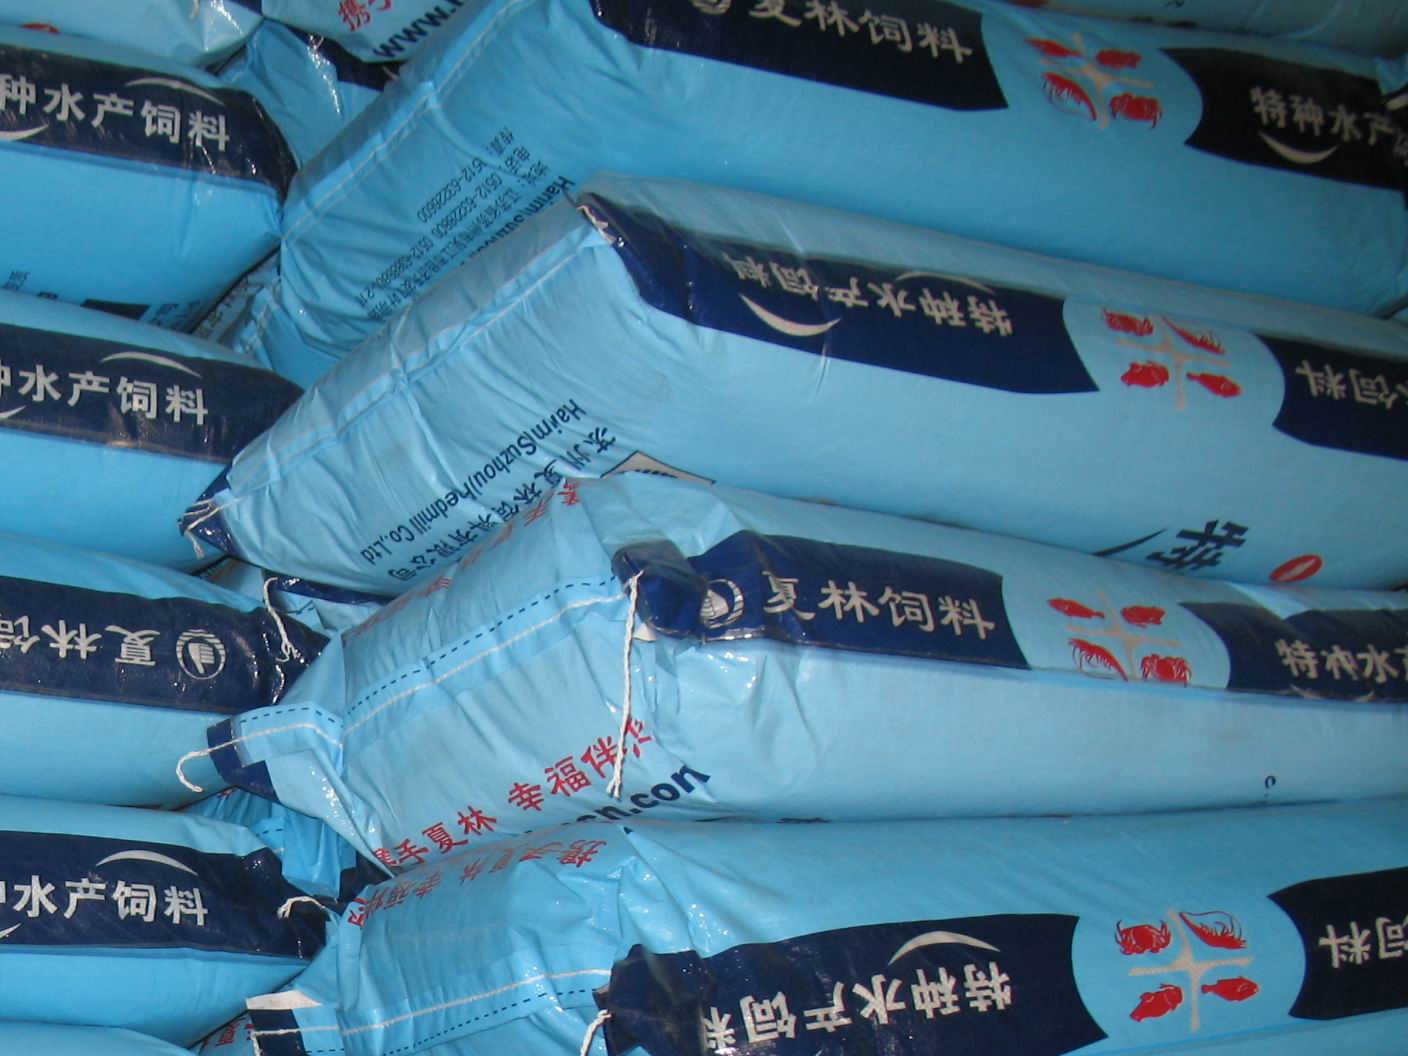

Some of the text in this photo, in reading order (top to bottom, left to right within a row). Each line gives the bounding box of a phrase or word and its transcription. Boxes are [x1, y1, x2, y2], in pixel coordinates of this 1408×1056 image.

[722, 252, 1012, 337] 特种水产饲料
[762, 571, 994, 640] 夏林饲料
[702, 961, 1012, 1051] 特种水产饲料
